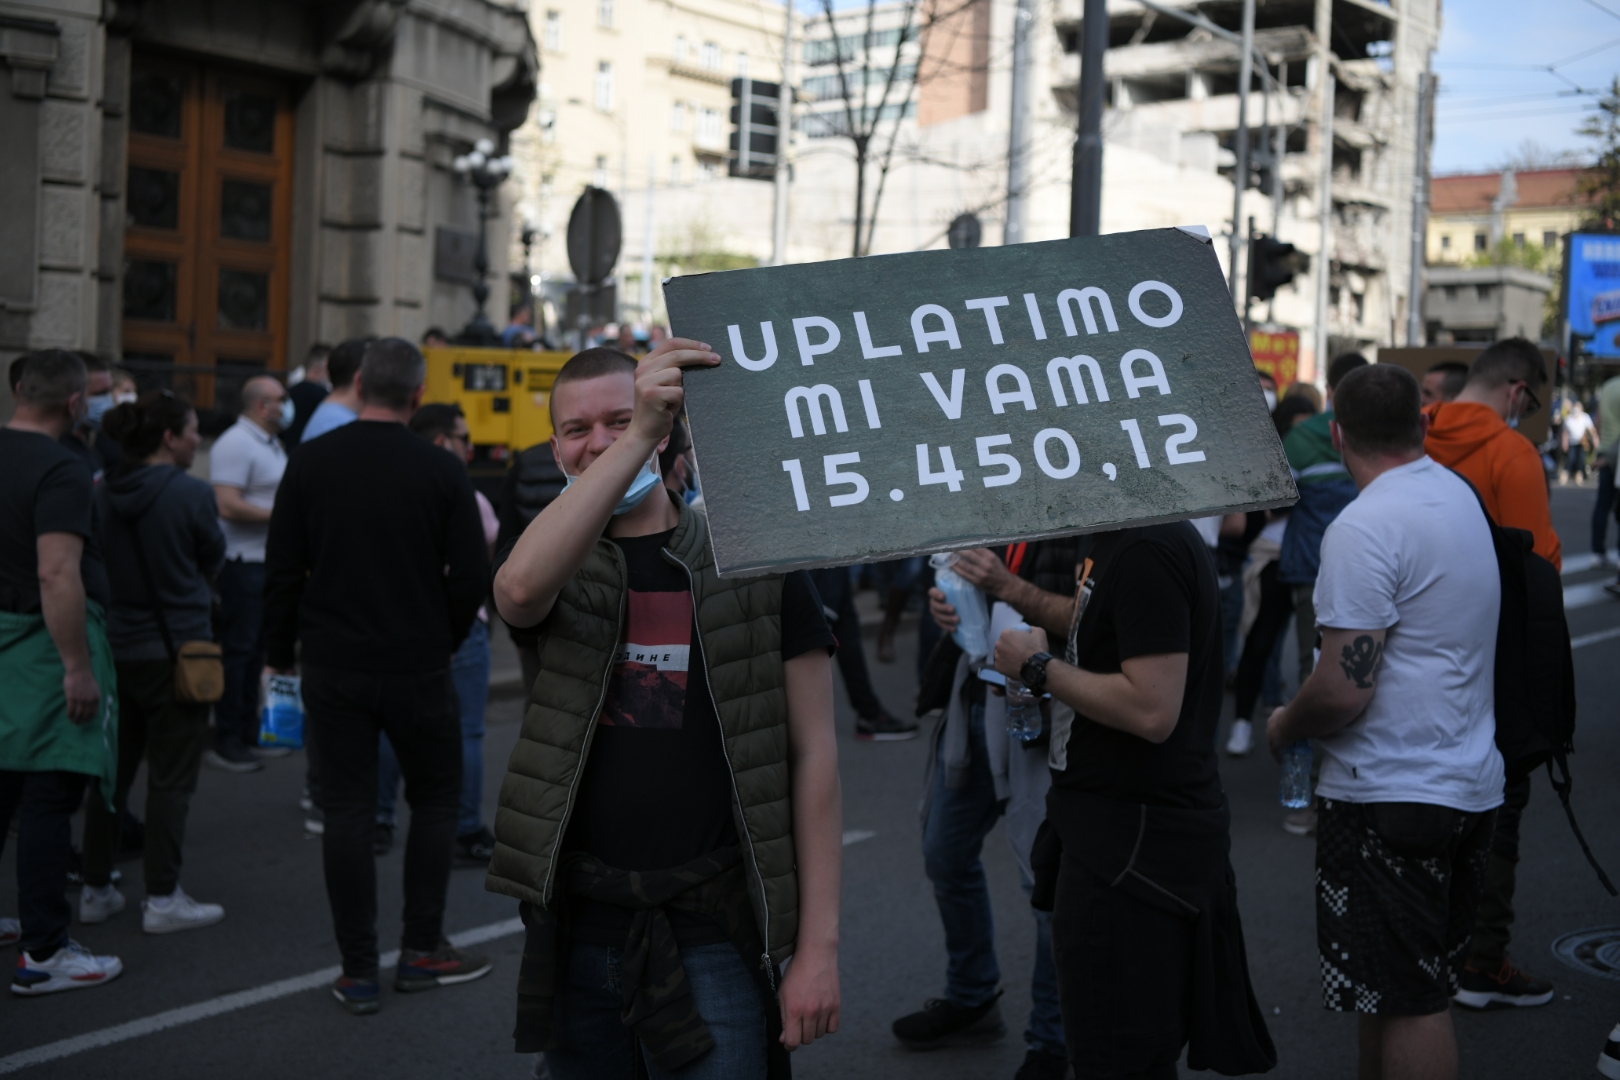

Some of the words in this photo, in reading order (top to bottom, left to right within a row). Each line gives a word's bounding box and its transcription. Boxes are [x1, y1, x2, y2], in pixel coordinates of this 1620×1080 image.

[727, 280, 1184, 372] UPLATIMO
[784, 379, 882, 439] MI
[919, 348, 1172, 420] VAMA
[781, 413, 1207, 512] 15.450,12
